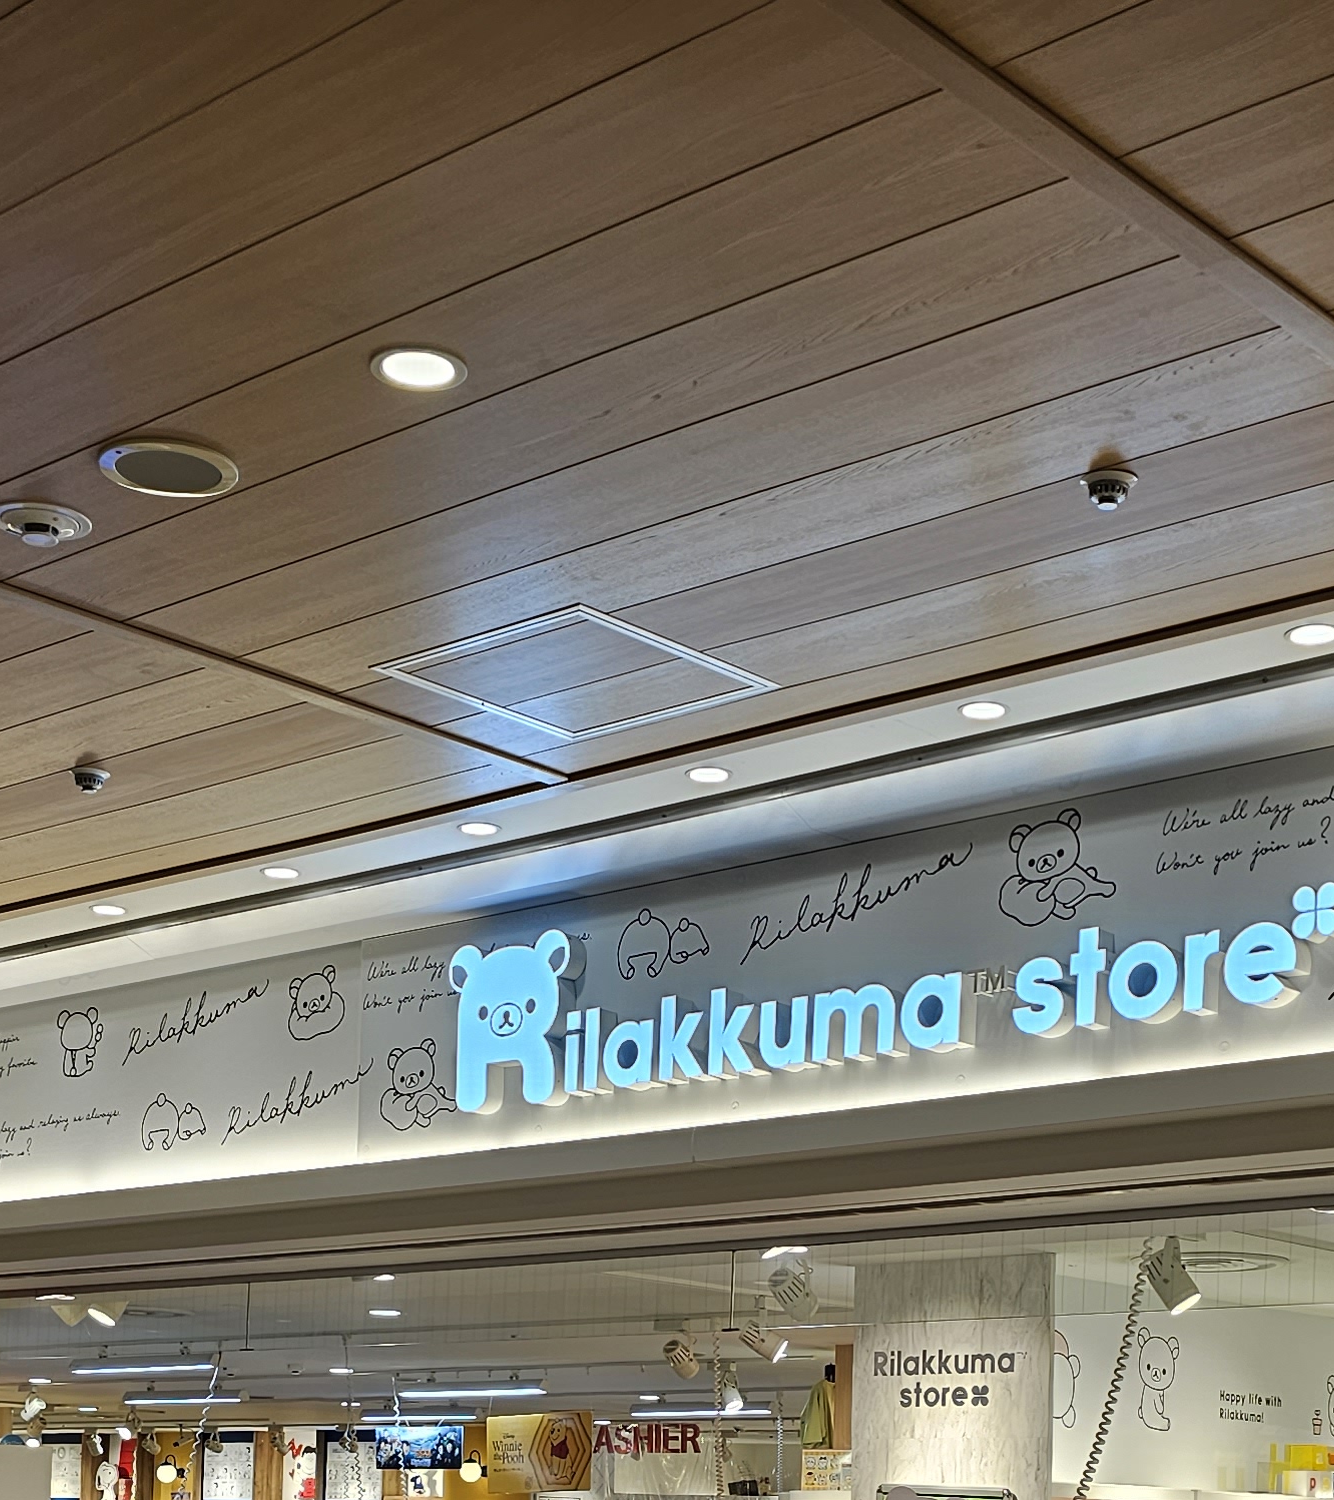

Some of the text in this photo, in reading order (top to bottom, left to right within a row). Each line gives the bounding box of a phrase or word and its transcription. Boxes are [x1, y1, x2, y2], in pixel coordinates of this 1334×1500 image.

[1163, 811, 1211, 837] We're
[1219, 799, 1249, 826] all
[1253, 794, 1296, 831] lazy
[1156, 816, 1332, 875] Won't you join us?
[741, 842, 973, 966] Rilakkuma
[400, 956, 420, 973] all
[417, 989, 444, 1012] join
[122, 979, 270, 1066] Rilakkuma
[449, 929, 965, 1114] Rilakkuma
[1013, 924, 1298, 1036] store
[221, 1057, 374, 1145] Rilakkuma
[873, 1349, 1015, 1377] Rilakkuma
[900, 1381, 968, 1408] store
[1219, 1389, 1283, 1408] Happy life with
[1219, 1408, 1265, 1425] Rilakkuma!
[492, 1441, 523, 1452] Winnie
[592, 1422, 702, 1457] ASHIER
[502, 1452, 525, 1464] Pooh
